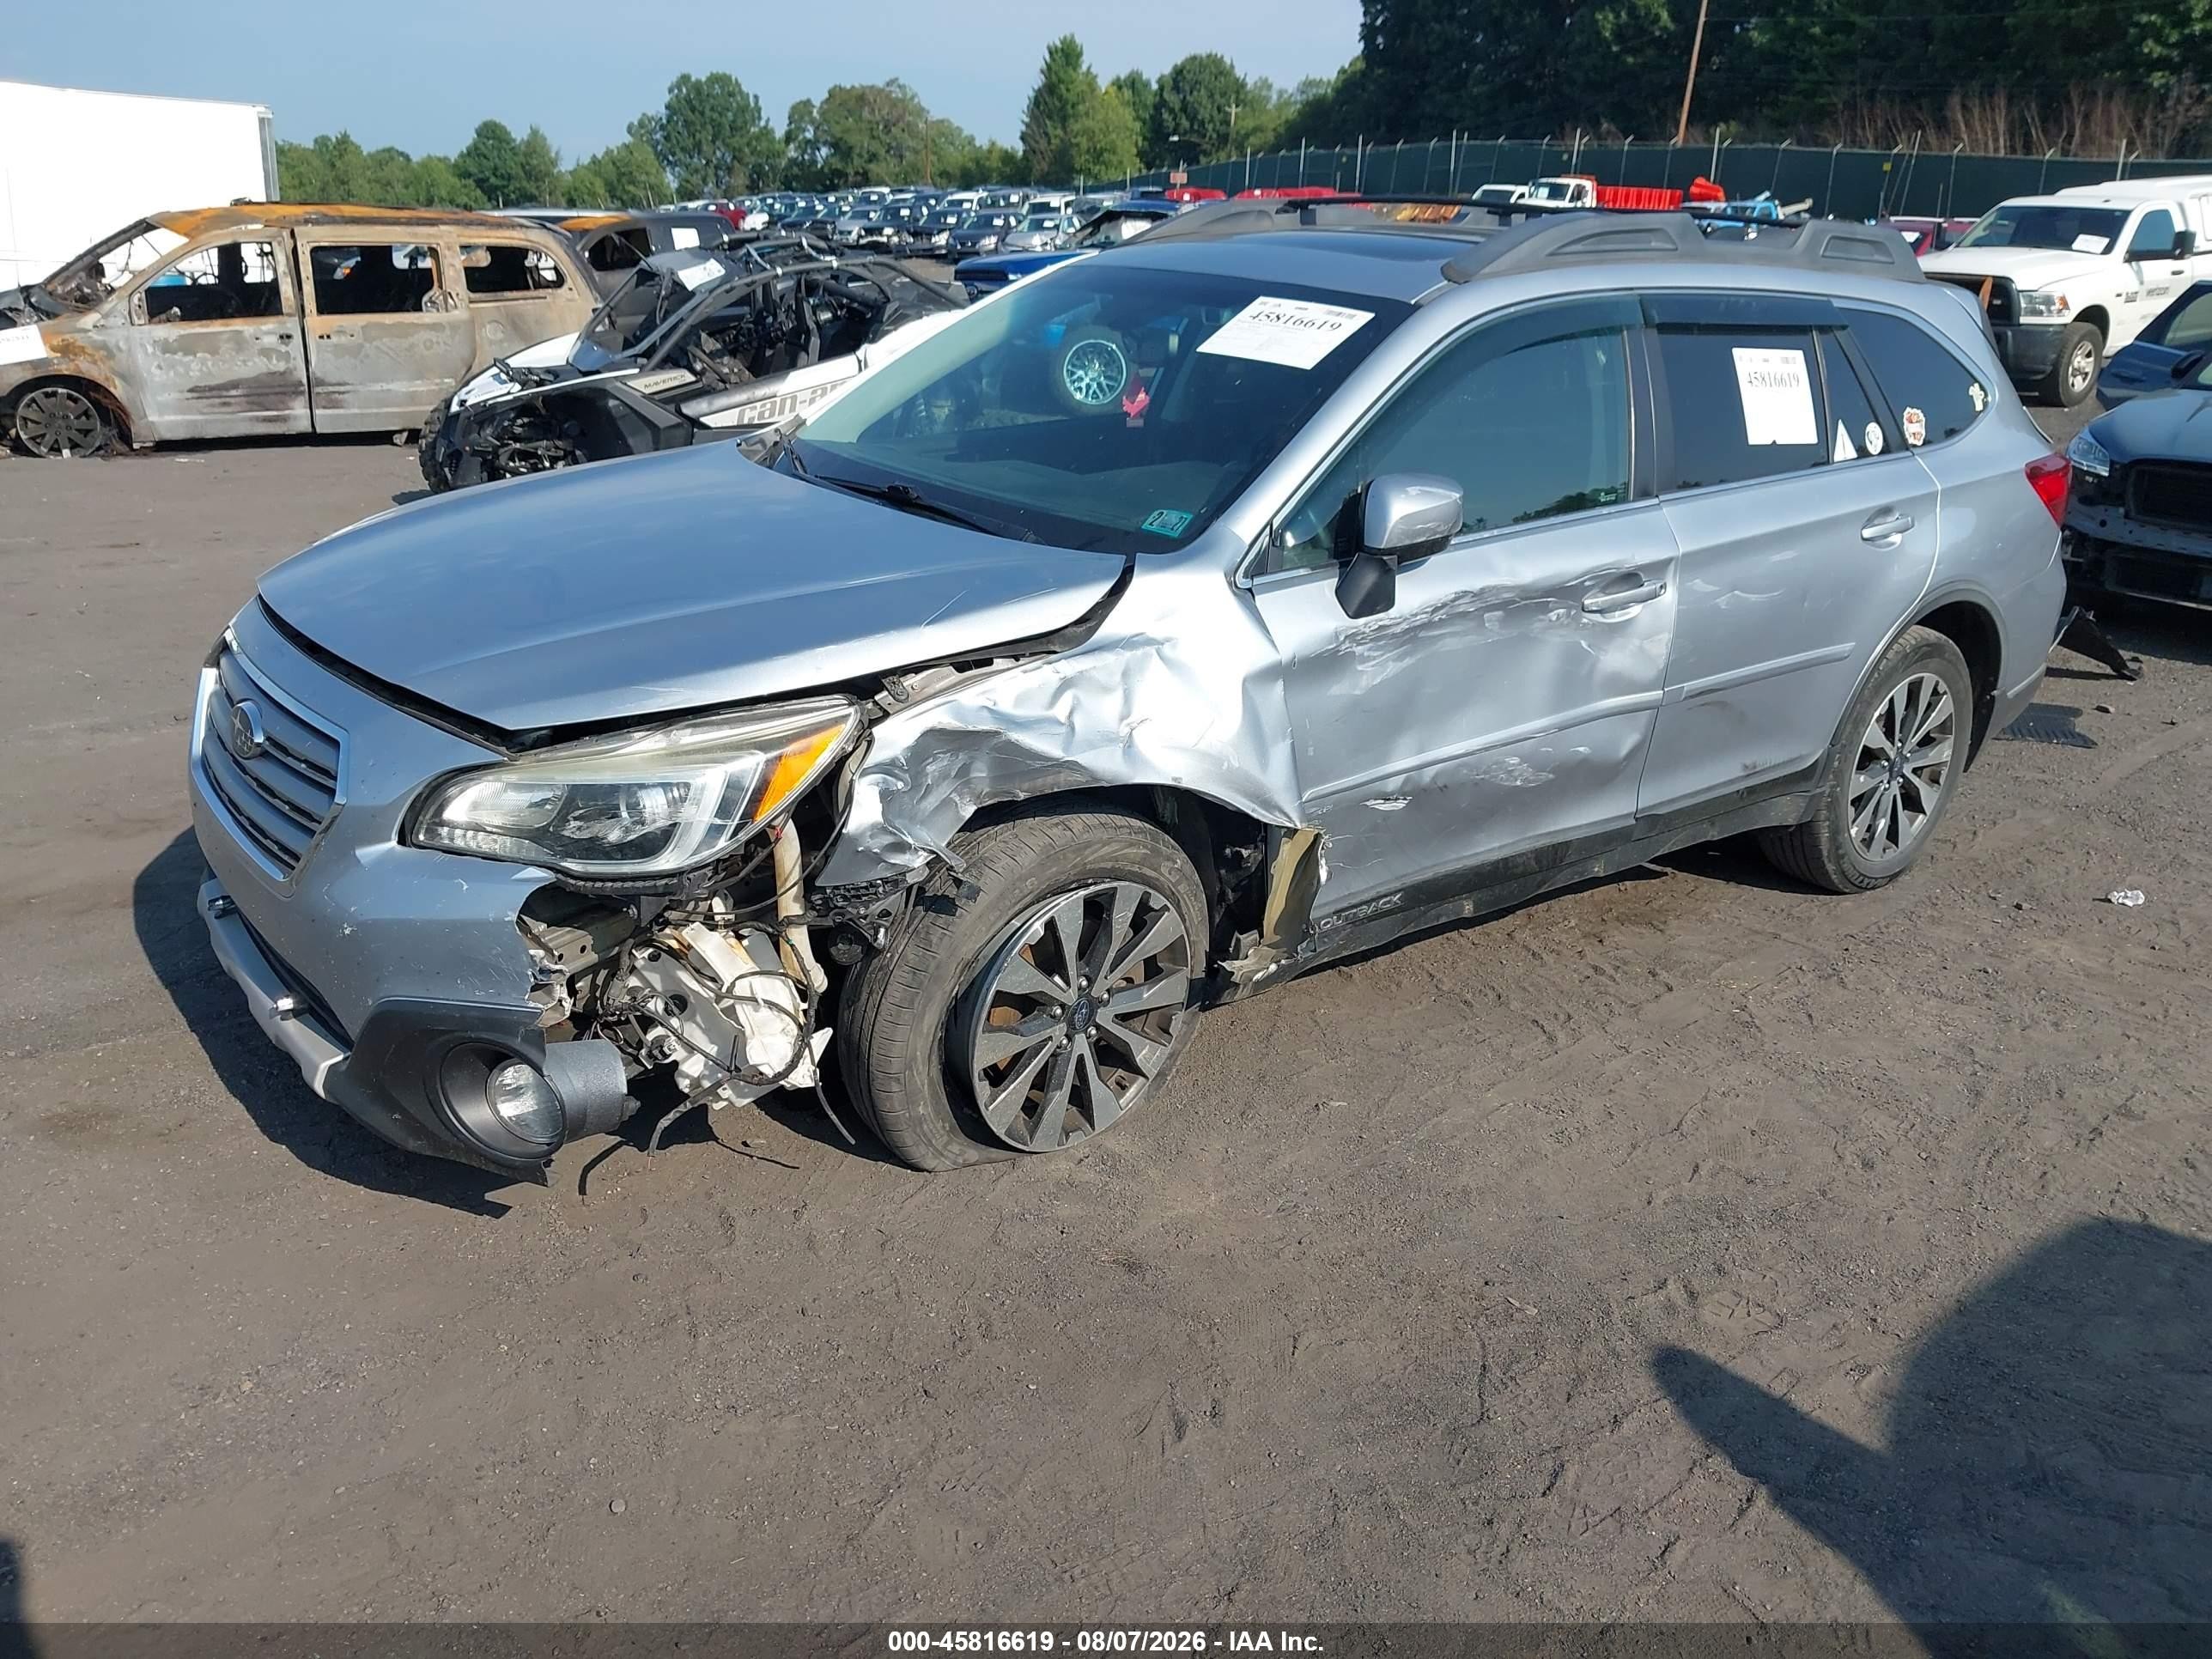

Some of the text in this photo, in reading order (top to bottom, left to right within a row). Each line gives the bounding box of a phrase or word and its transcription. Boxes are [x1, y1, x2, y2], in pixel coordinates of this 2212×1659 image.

[1249, 310, 1342, 332] 45816619
[643, 374, 686, 390] MAVERICK
[1747, 371, 1800, 388] 45816619
[737, 380, 847, 426] can-a
[1320, 892, 1403, 930] OUTBACK
